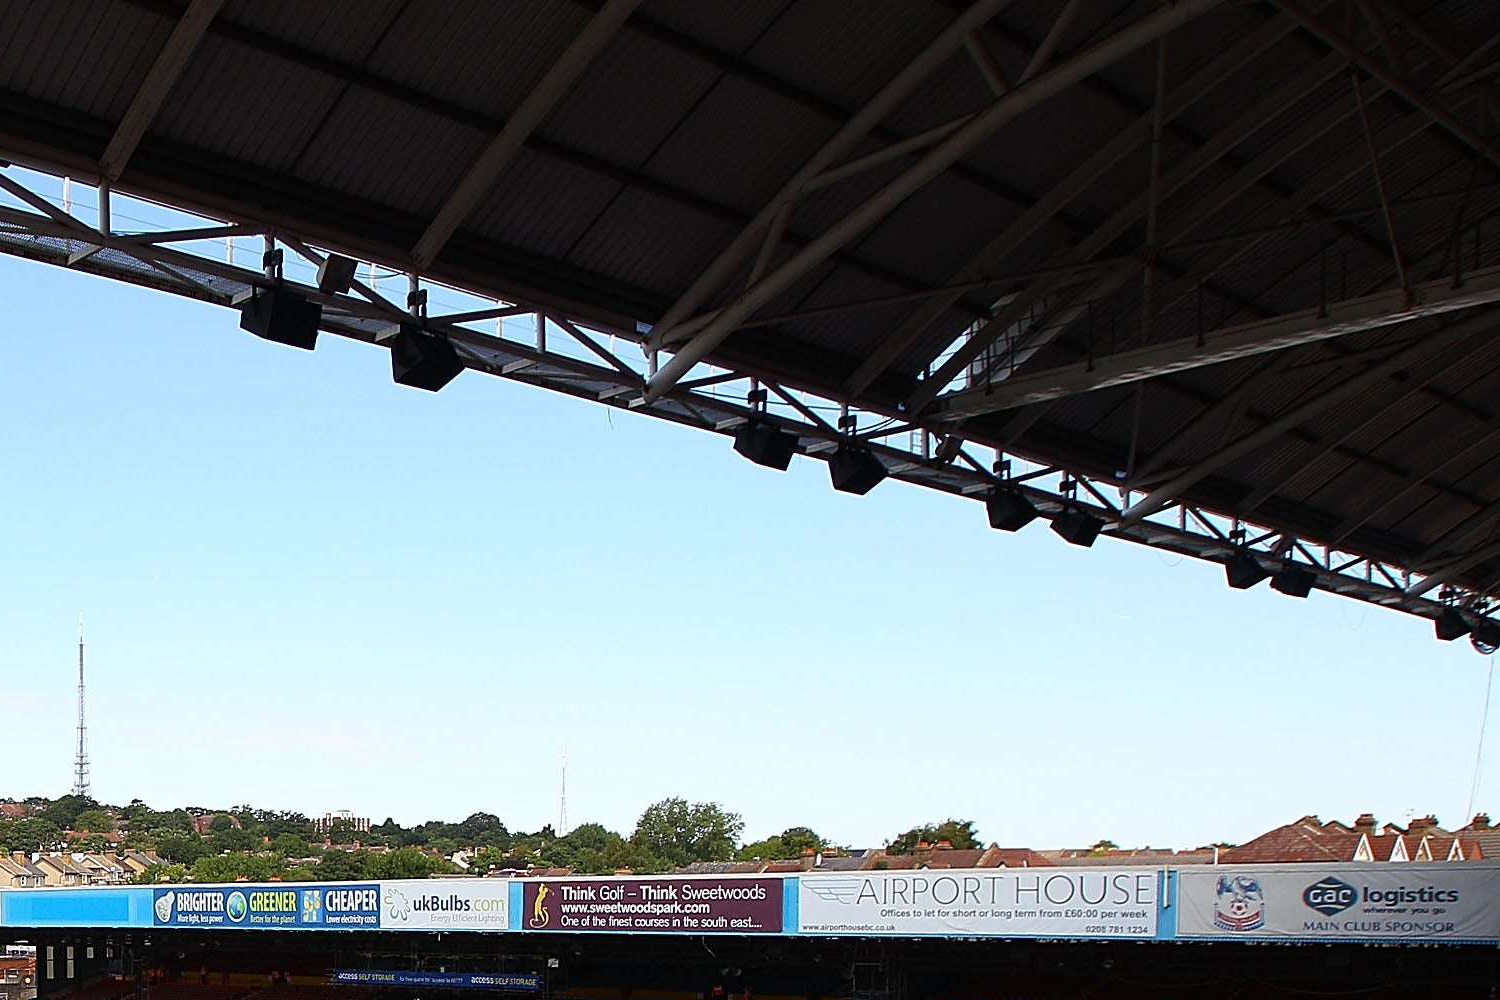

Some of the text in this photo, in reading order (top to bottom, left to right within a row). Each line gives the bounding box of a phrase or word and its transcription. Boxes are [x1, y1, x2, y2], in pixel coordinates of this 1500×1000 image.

[561, 884, 766, 900] Think Golf Think Sweetwoods
[856, 874, 1153, 904] AIRPORT HOUSE
[177, 892, 224, 912] BRIGHTER
[250, 892, 296, 912] GREENER
[326, 890, 378, 911] CHEAPER
[1364, 886, 1458, 906] logistics
[413, 895, 504, 911] ukBulbs.com
[561, 902, 710, 914] www.sweetwoodspark.com
[210, 916, 223, 924] power
[280, 916, 296, 924] planet
[326, 915, 376, 925] Lower electricity costs
[431, 914, 450, 922] Energy
[478, 914, 504, 924] Lighting
[881, 908, 911, 918] Offices
[913, 910, 922, 918] to
[924, 909, 936, 918] let
[938, 909, 950, 918] for
[952, 909, 976, 918] short
[991, 910, 1012, 920] long
[1040, 910, 1062, 918] from
[1064, 910, 1098, 918] £60:00
[1101, 910, 1118, 920] per
[1121, 910, 1148, 918] week
[561, 916, 579, 927] One
[582, 916, 590, 926] of
[592, 916, 606, 927] the
[609, 916, 632, 928] finest
[634, 918, 670, 928] courses
[672, 916, 680, 928] in
[683, 916, 698, 928] the
[701, 916, 728, 928] south
[1303, 922, 1454, 932] MAIN CLUB SPONSOR
[1128, 926, 1148, 934] 1234
[471, 976, 494, 984] access
[510, 978, 536, 986] STORAGE
